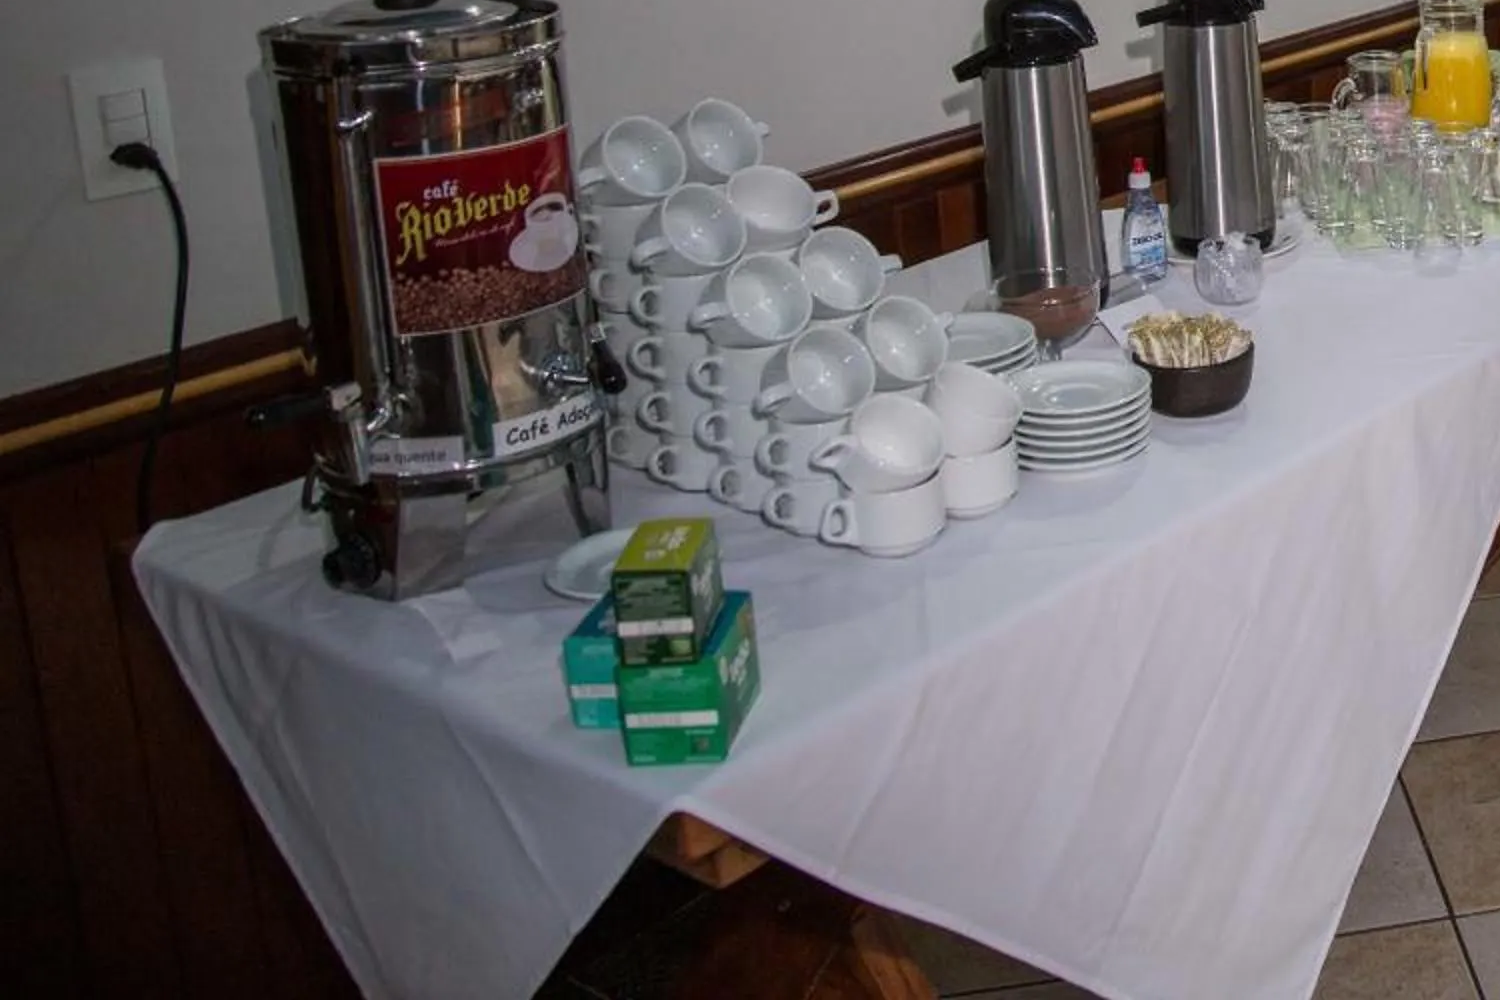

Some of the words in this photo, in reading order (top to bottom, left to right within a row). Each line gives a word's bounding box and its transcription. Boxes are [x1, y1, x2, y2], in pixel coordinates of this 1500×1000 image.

[423, 179, 460, 201] café
[506, 416, 551, 446] Café
[557, 404, 594, 430] Adoç
